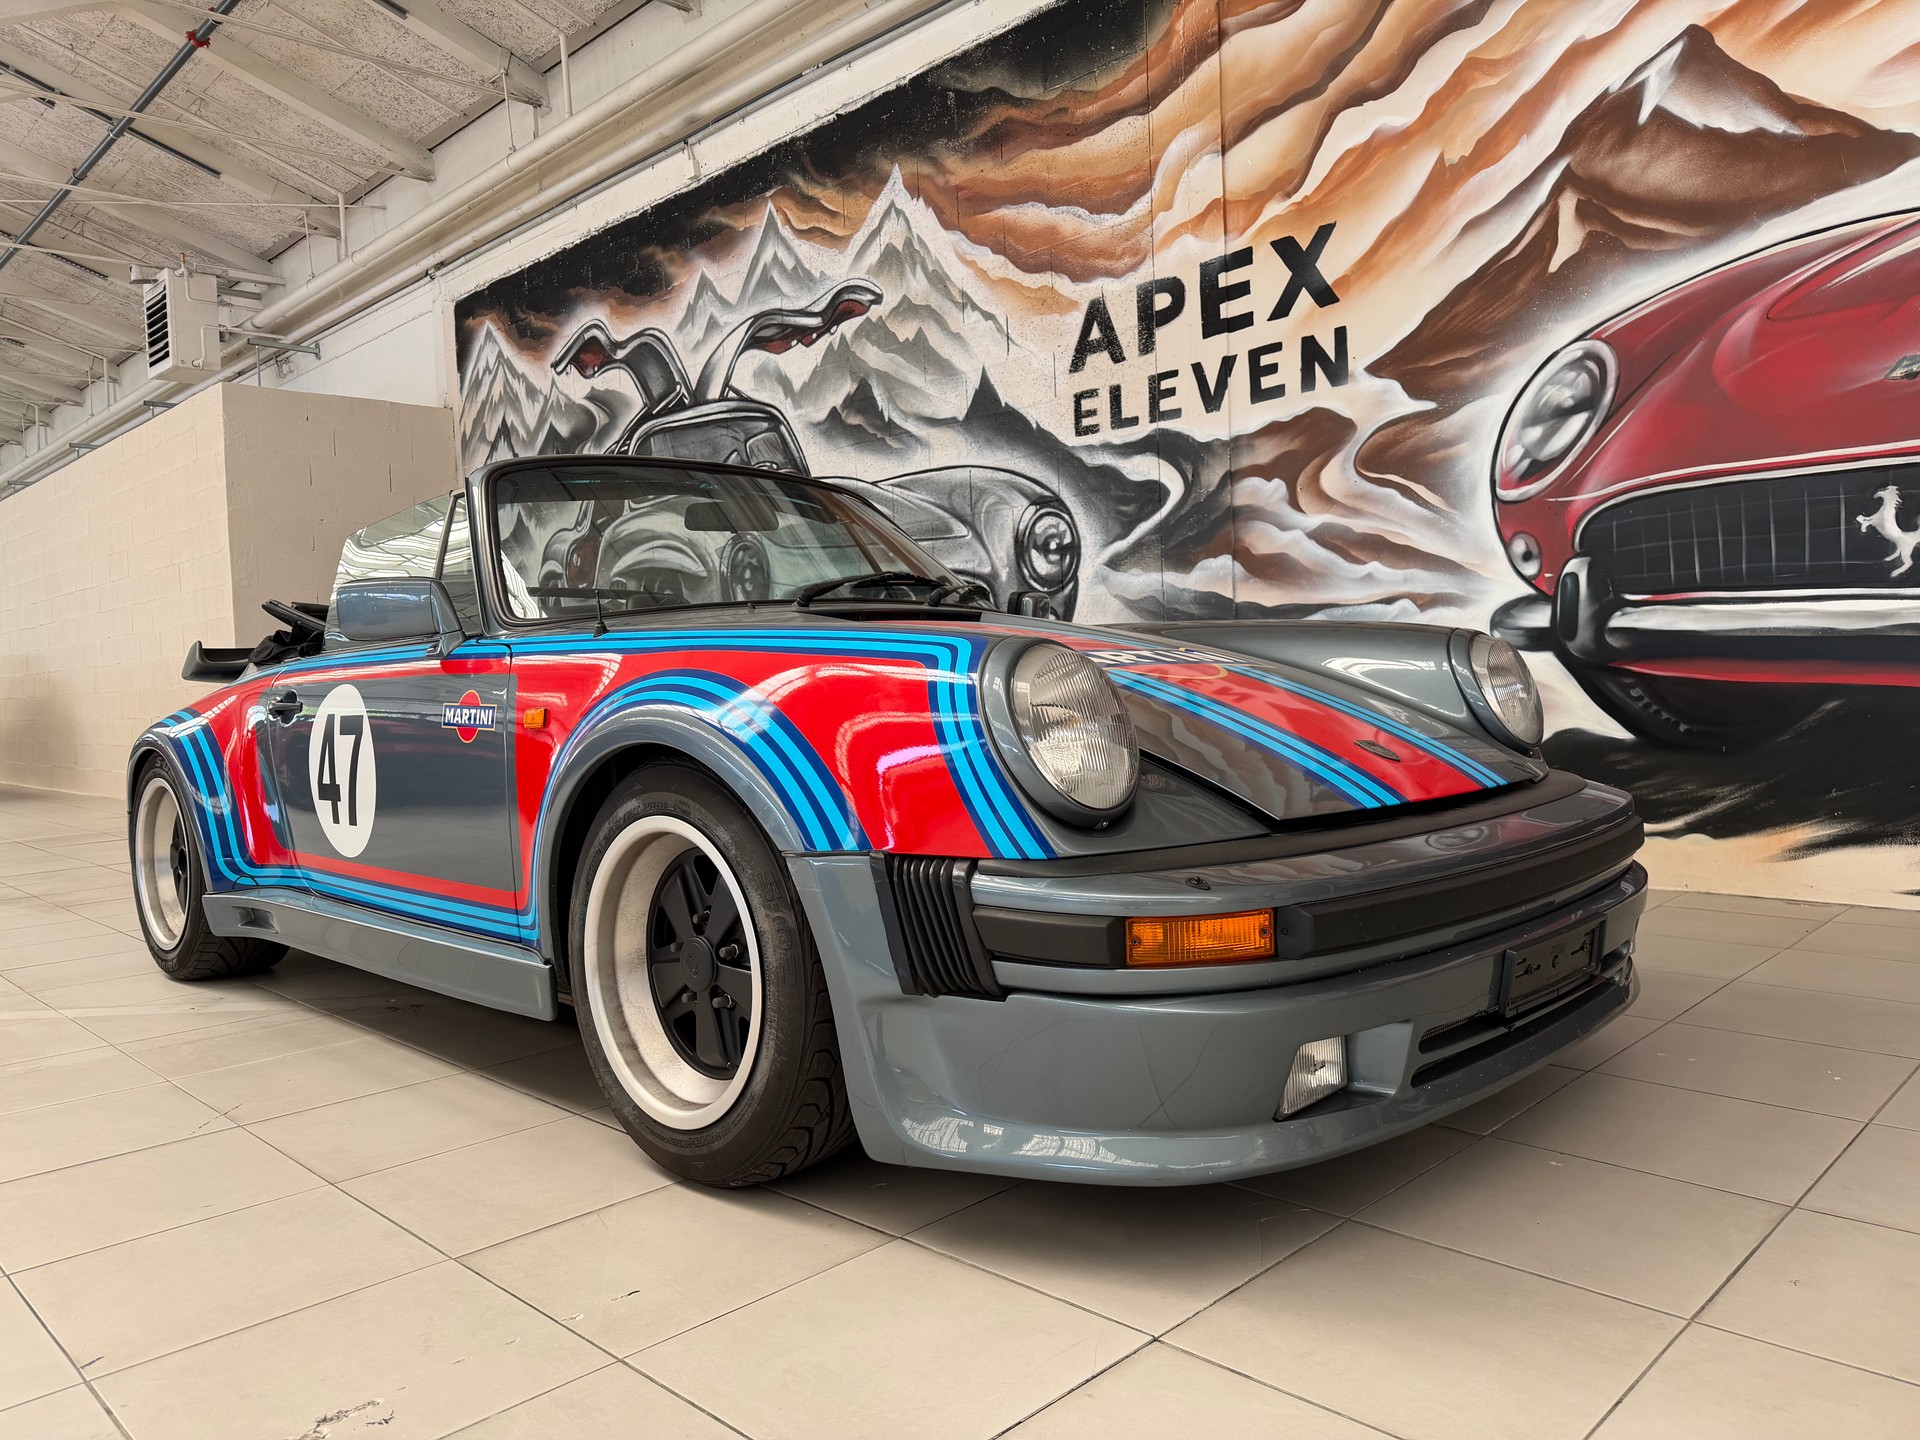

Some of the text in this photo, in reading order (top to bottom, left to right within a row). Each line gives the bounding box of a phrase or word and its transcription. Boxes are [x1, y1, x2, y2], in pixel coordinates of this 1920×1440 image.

[1068, 221, 1340, 374] APEX
[1073, 325, 1349, 437] ELEVEN
[1086, 650, 1248, 664] RTINI
[317, 713, 364, 827] 47
[444, 707, 494, 726] MARTINI
